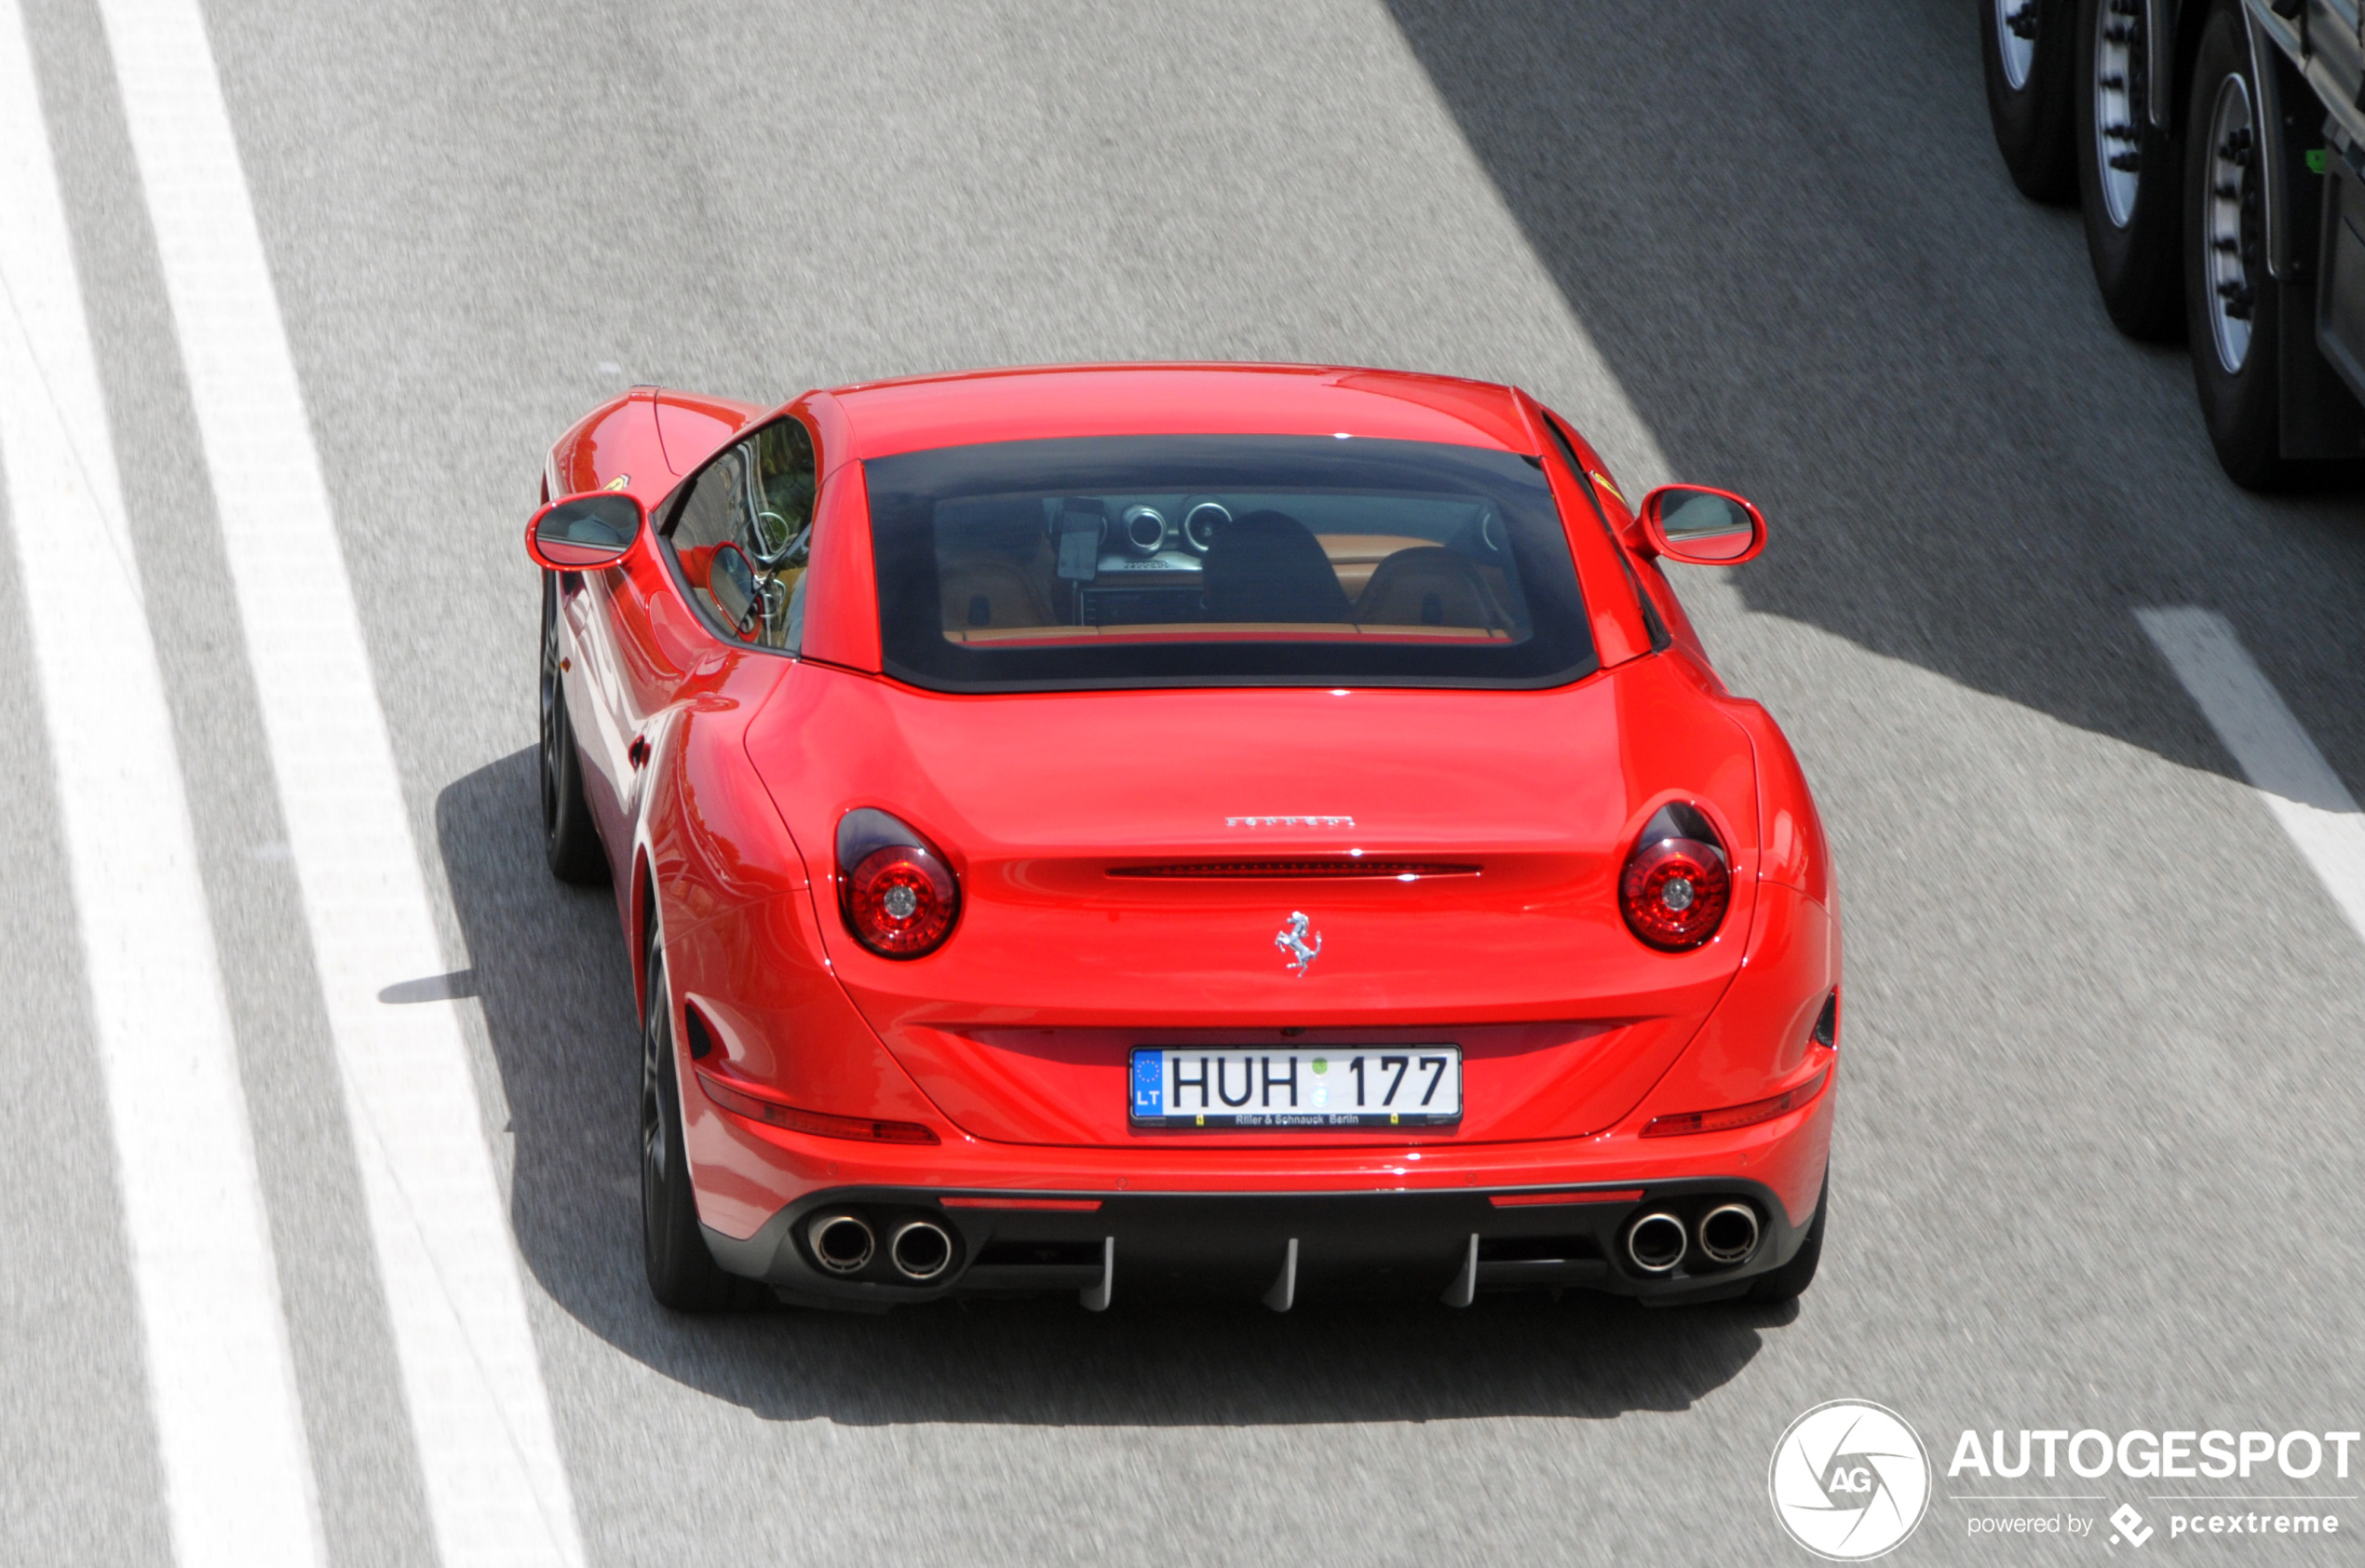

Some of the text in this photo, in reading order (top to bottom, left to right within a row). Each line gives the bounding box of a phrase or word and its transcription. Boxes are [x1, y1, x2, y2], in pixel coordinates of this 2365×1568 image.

[1172, 1056, 1448, 1108] HUH 177
[1137, 1090, 1160, 1105] LT
[1264, 1114, 1273, 1124] &
[1275, 1114, 1323, 1125] Schnauck
[1329, 1113, 1358, 1124] Berlin
